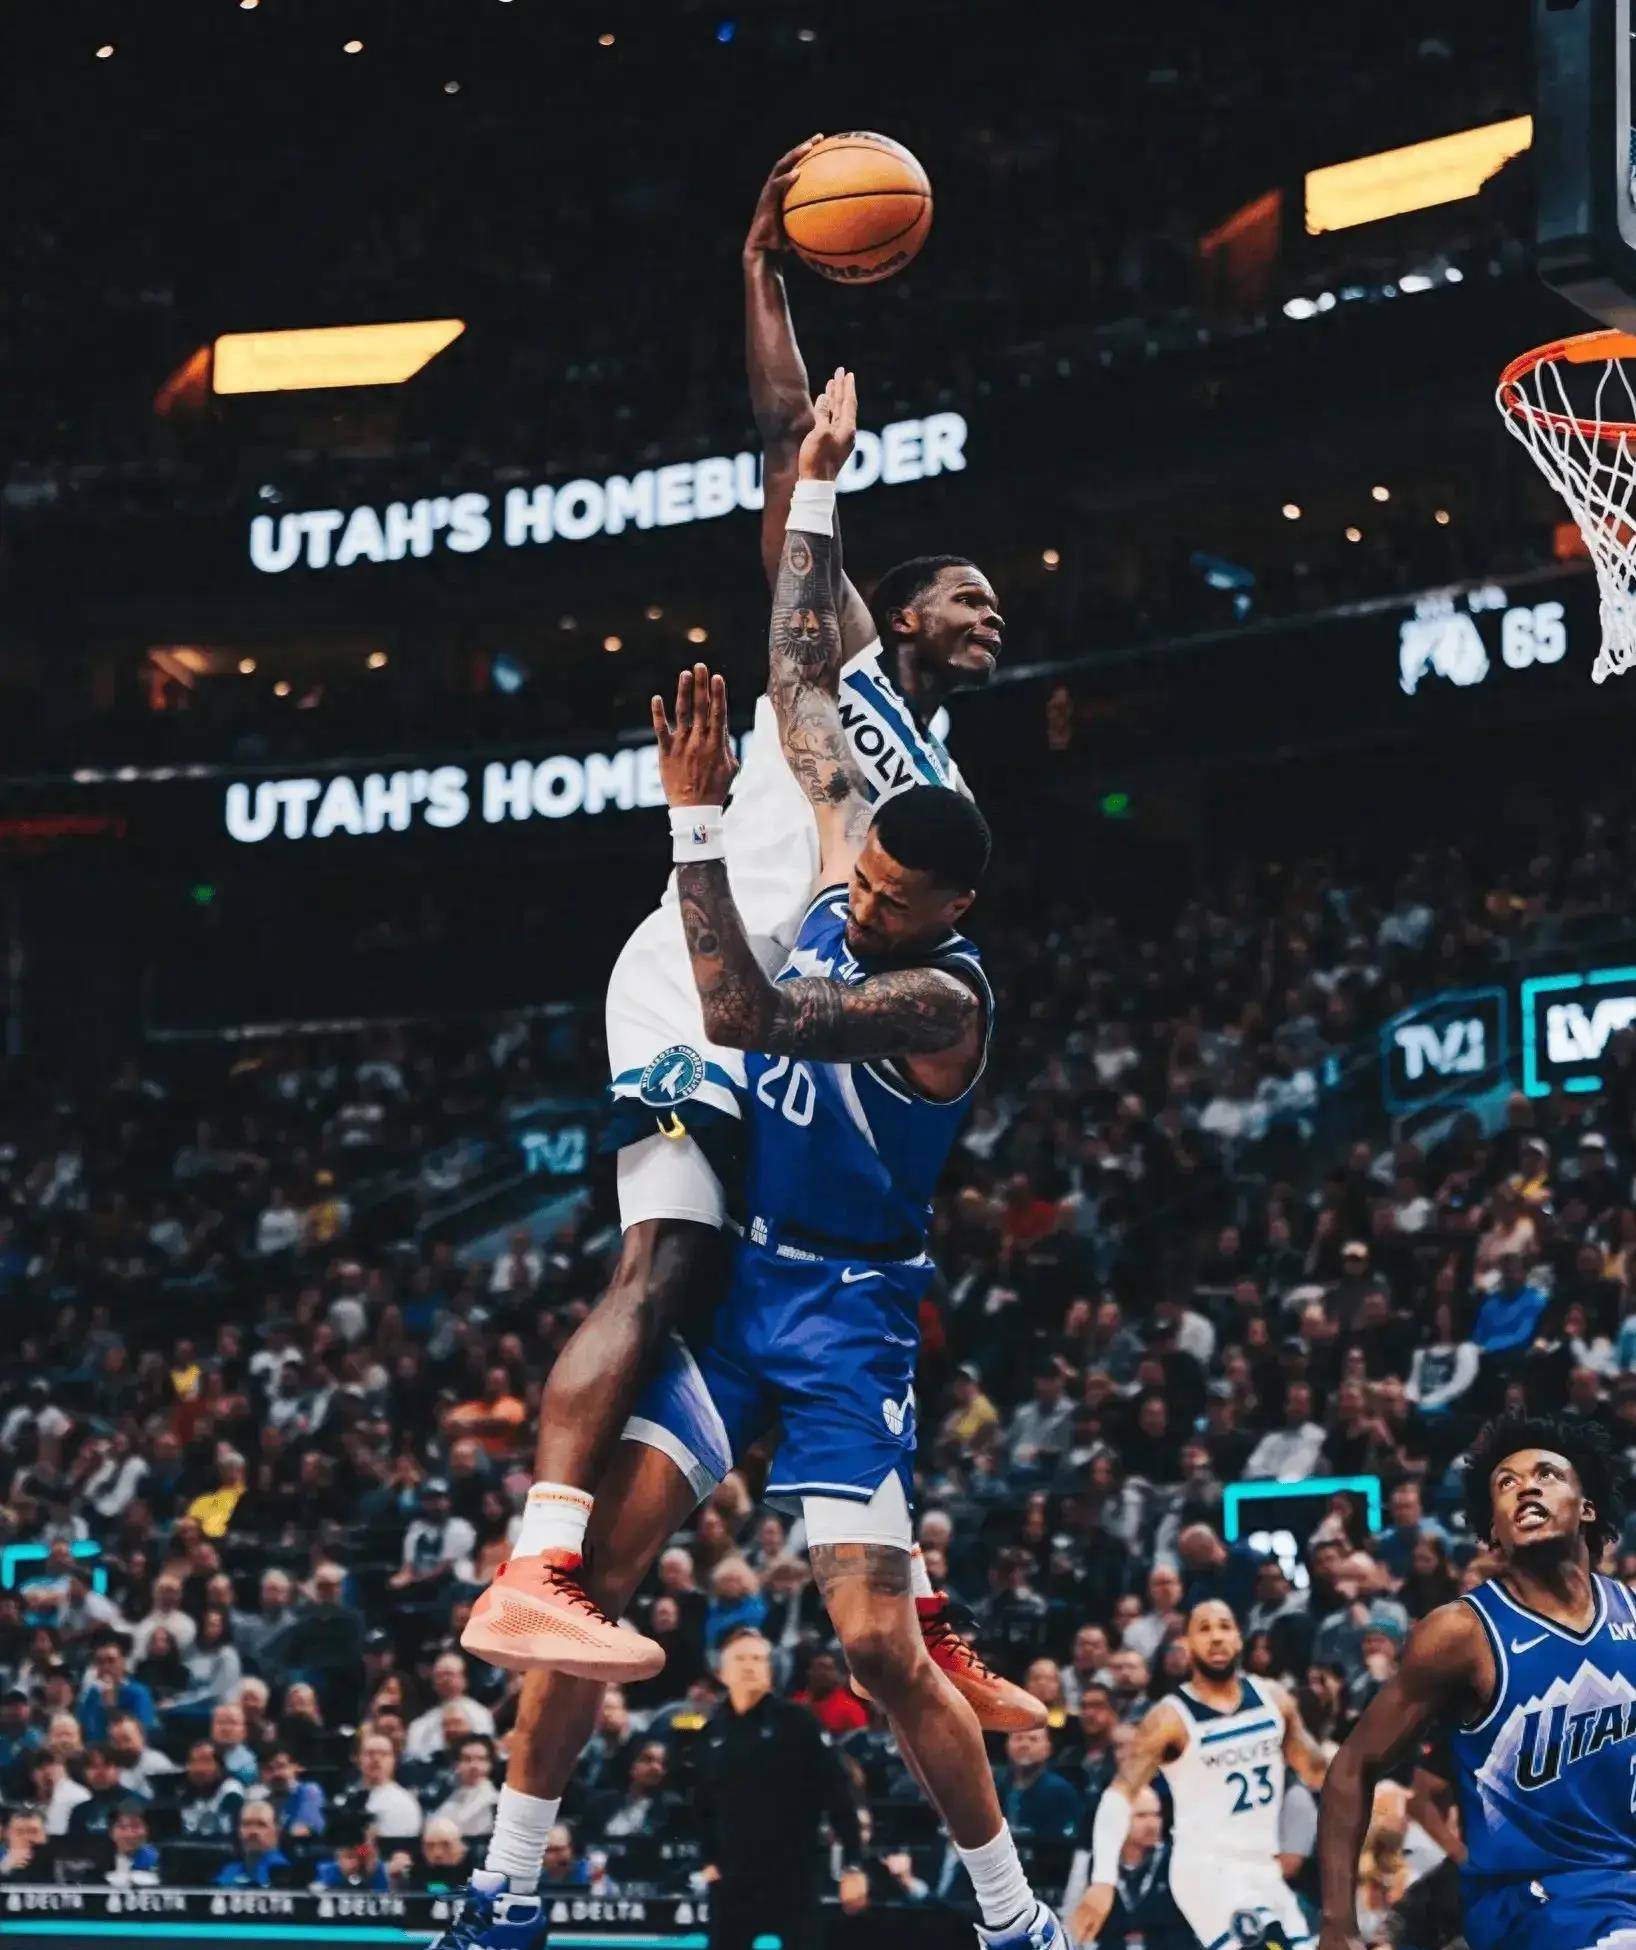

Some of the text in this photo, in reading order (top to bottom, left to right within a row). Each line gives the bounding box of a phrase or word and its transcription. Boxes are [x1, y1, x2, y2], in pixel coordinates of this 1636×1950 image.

[250, 411, 968, 573] UTAH'S HOMEBUDER
[1502, 601, 1567, 669] 65
[225, 765, 470, 843] UTAH'S
[757, 1052, 816, 1127] 20
[1225, 1763, 1275, 1815] 23
[572, 1900, 645, 1921] DELTA
